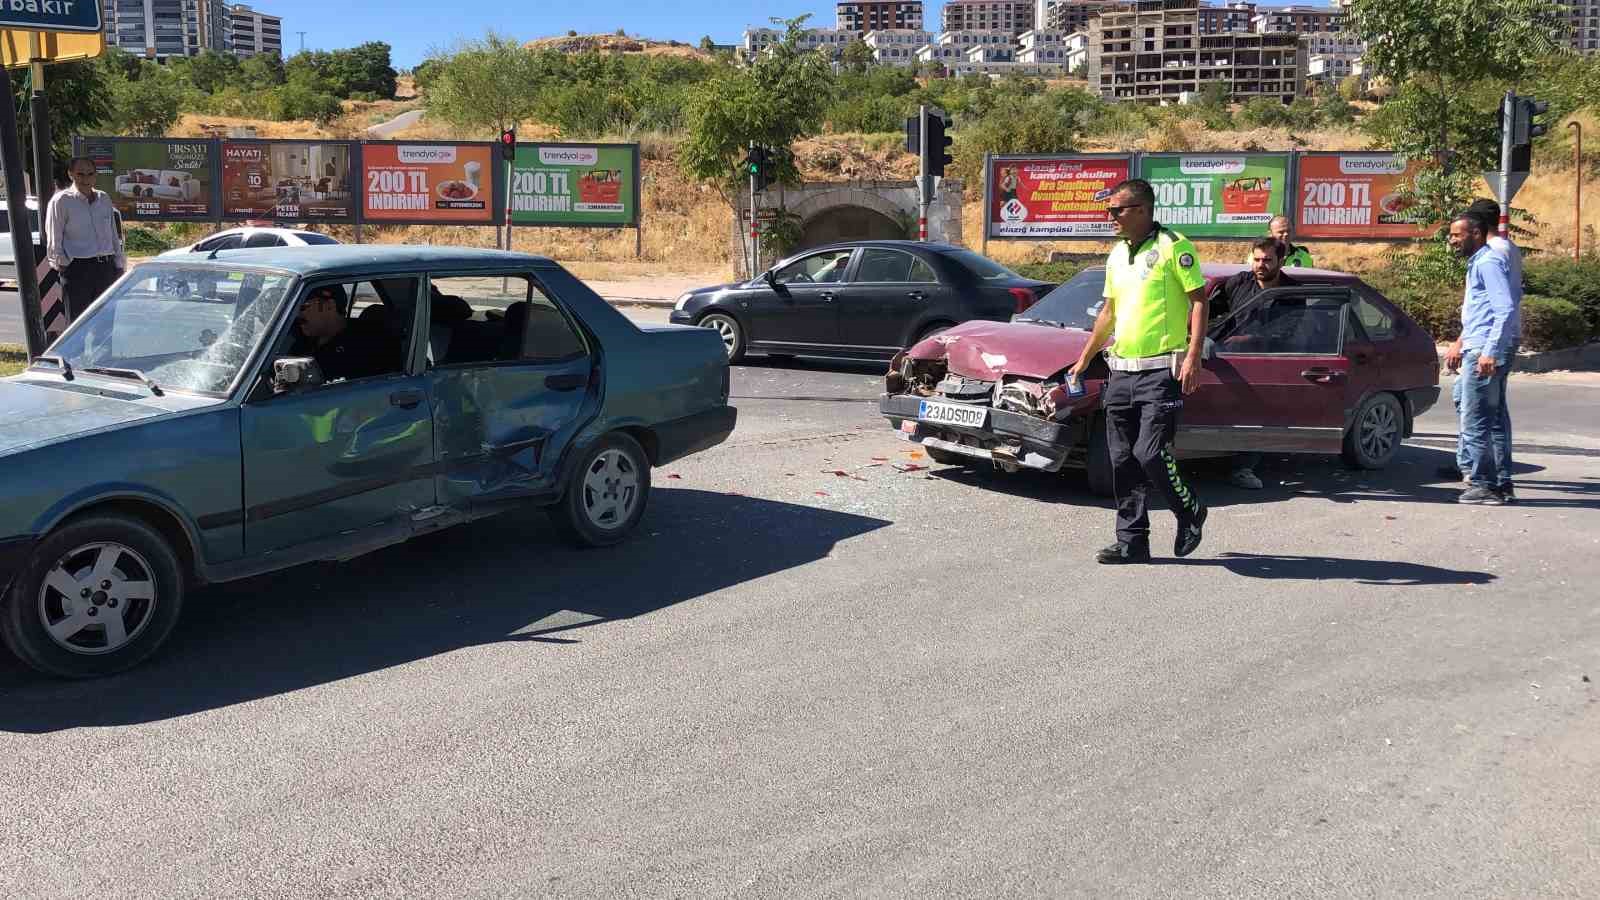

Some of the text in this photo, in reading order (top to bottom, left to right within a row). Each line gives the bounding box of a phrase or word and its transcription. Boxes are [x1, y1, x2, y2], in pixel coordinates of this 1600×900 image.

[403, 150, 437, 160] trendyol
[544, 152, 578, 162] trendyol
[1186, 159, 1224, 169] trendyol
[1345, 160, 1384, 169] trendyol
[367, 170, 429, 193] 200 TL
[512, 172, 571, 195] 200 TL
[1030, 171, 1073, 180] kampüs
[368, 193, 430, 210] İNDİRİM!
[1191, 182, 1213, 206] TL
[1303, 182, 1372, 206] 200 TL
[1152, 207, 1212, 225] NDİRİM!
[1302, 207, 1371, 225] İNDİRİM!
[1029, 225, 1073, 233] kampüsü
